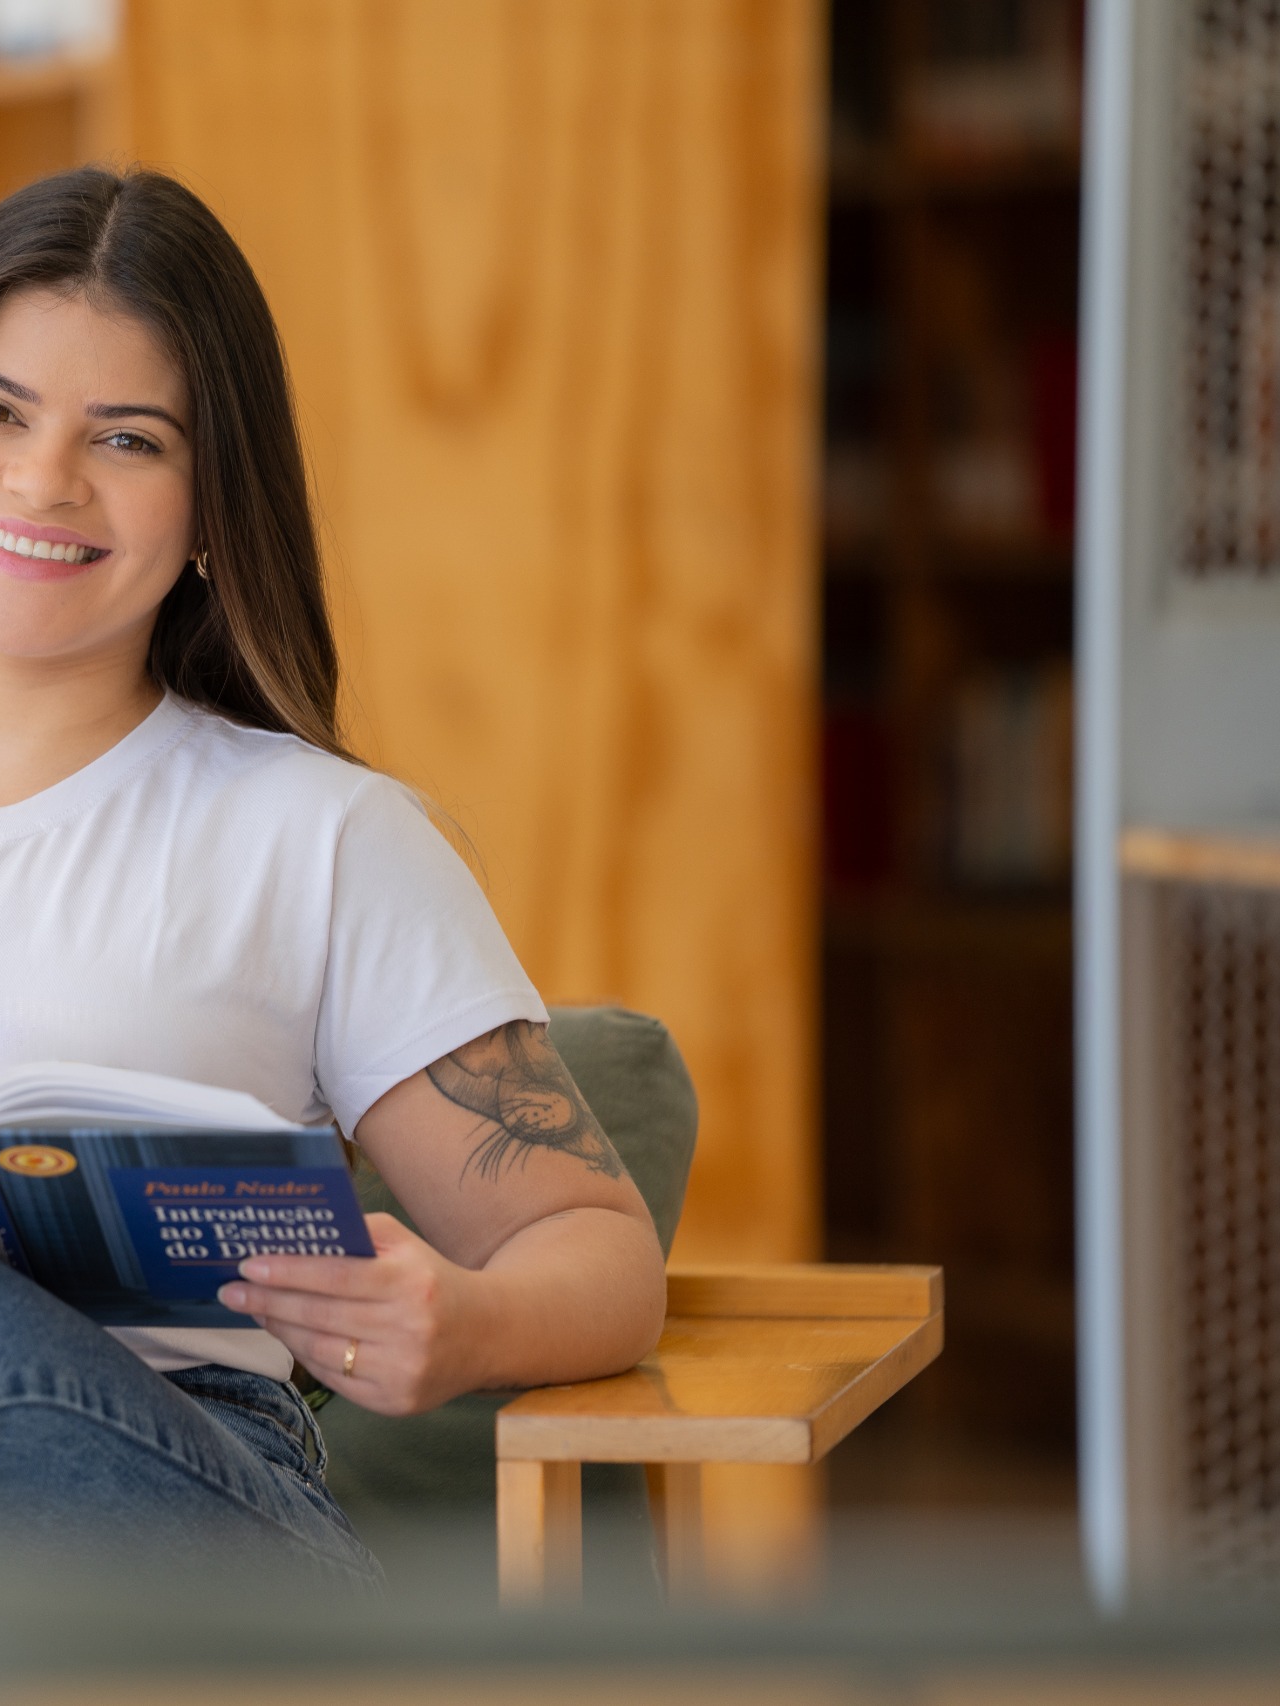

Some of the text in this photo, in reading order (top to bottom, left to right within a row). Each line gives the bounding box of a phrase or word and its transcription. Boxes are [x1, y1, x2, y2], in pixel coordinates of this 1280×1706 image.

[145, 1181, 324, 1196] Paulo Nader
[155, 1205, 334, 1225] Introdução
[160, 1223, 340, 1241] ao Estudo
[165, 1241, 209, 1259] do
